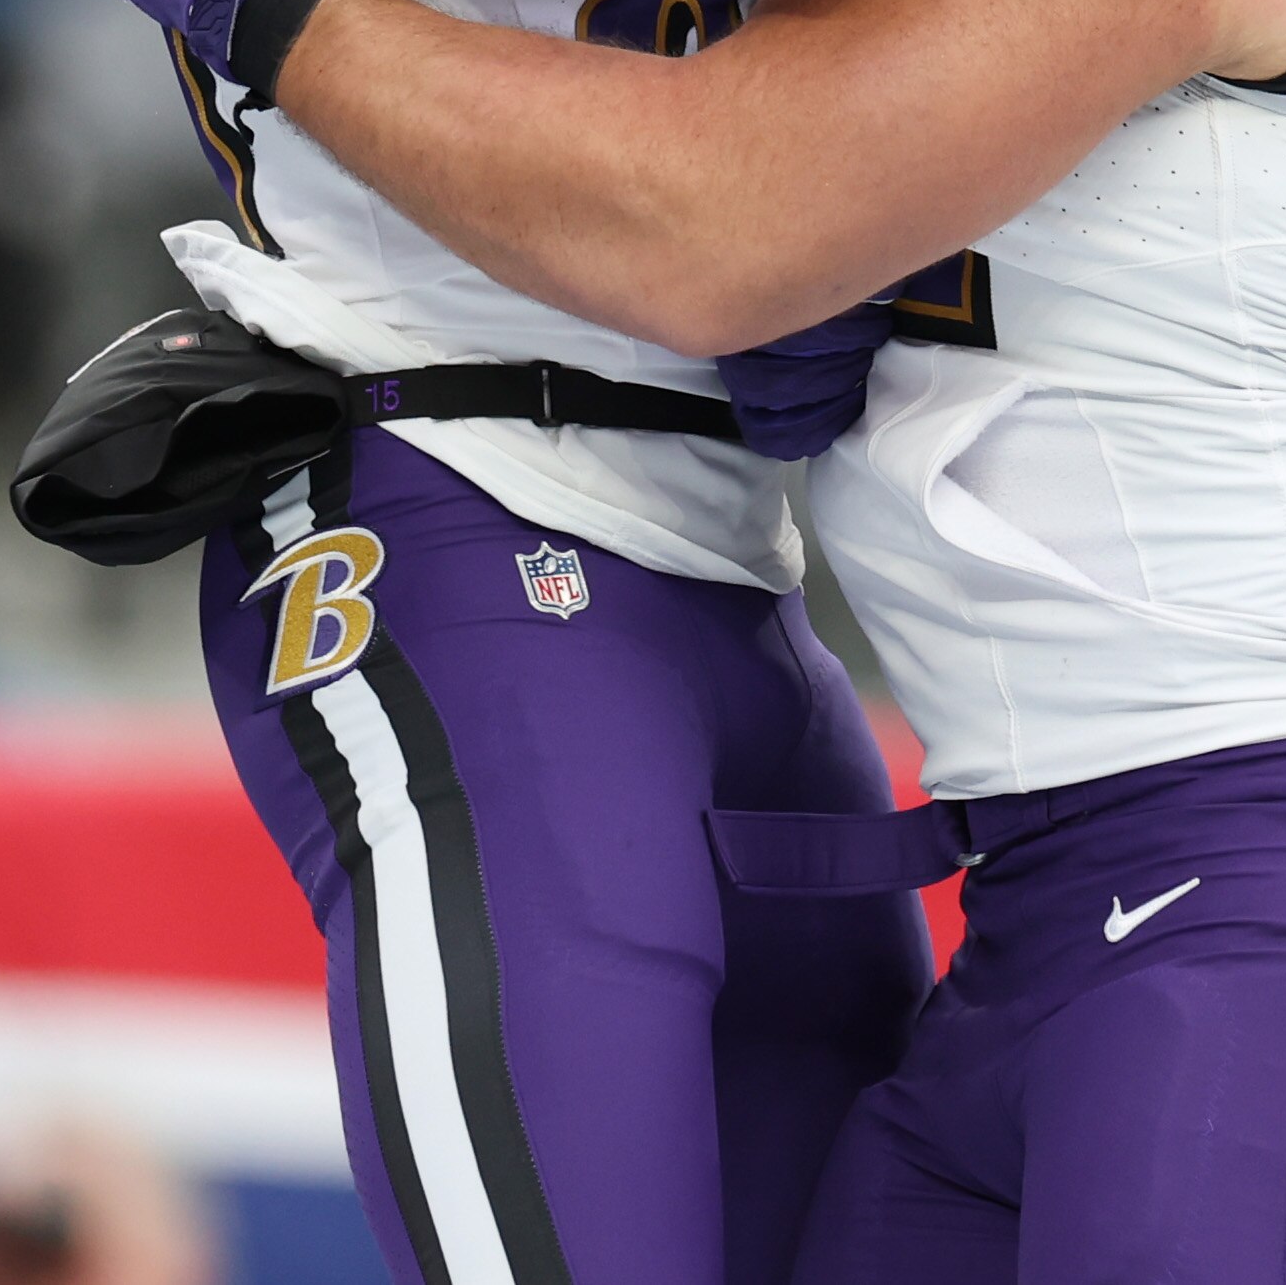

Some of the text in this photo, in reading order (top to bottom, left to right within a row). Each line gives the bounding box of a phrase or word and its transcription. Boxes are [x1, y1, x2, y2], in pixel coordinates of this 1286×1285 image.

[365, 379, 401, 413] 15
[534, 575, 581, 604] NFL
[238, 525, 386, 697] B
